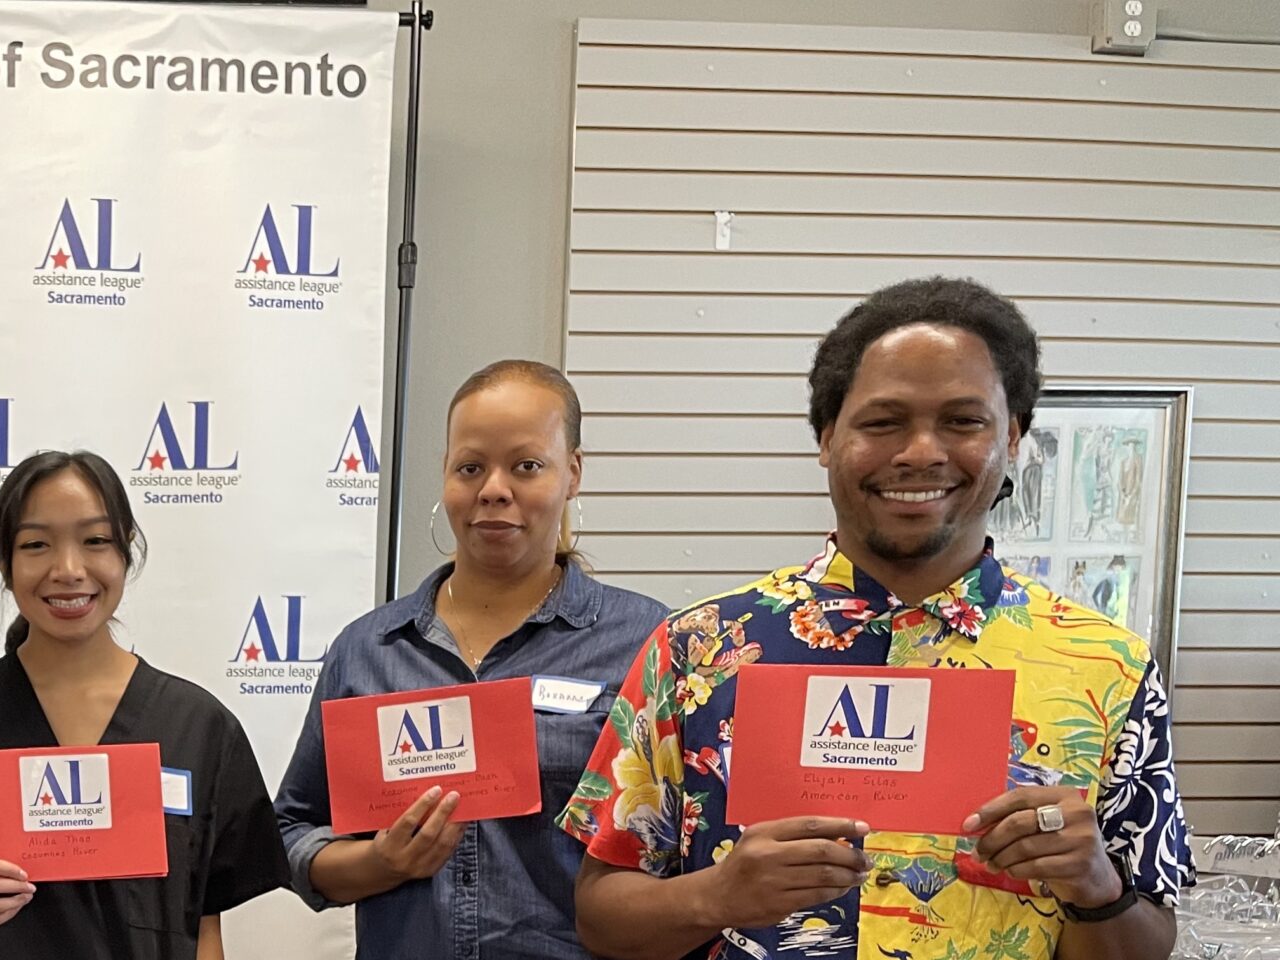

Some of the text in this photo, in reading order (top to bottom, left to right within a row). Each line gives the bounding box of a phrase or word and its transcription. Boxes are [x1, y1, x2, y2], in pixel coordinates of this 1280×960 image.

[40, 42, 368, 98] Sacramento
[35, 197, 141, 273] AL
[236, 203, 340, 277] AL
[32, 272, 96, 287] assistance
[234, 277, 296, 292] assistance
[47, 290, 126, 307] Sacramento
[248, 294, 324, 311] Sacramento
[131, 400, 239, 471] AL
[129, 473, 193, 487] assistance
[143, 491, 223, 504] Sacramento
[227, 595, 328, 662] AL
[226, 664, 285, 678] assistance
[239, 682, 312, 695] Sacramento
[812, 683, 916, 741] AL
[388, 704, 465, 756] AL
[810, 738, 869, 751] assistance
[387, 753, 433, 766] assistance
[822, 753, 898, 766] Sacramento
[399, 762, 456, 776] Sacramento
[30, 760, 102, 806] AL
[28, 806, 72, 817] assistance
[39, 817, 94, 828] Sacramento
